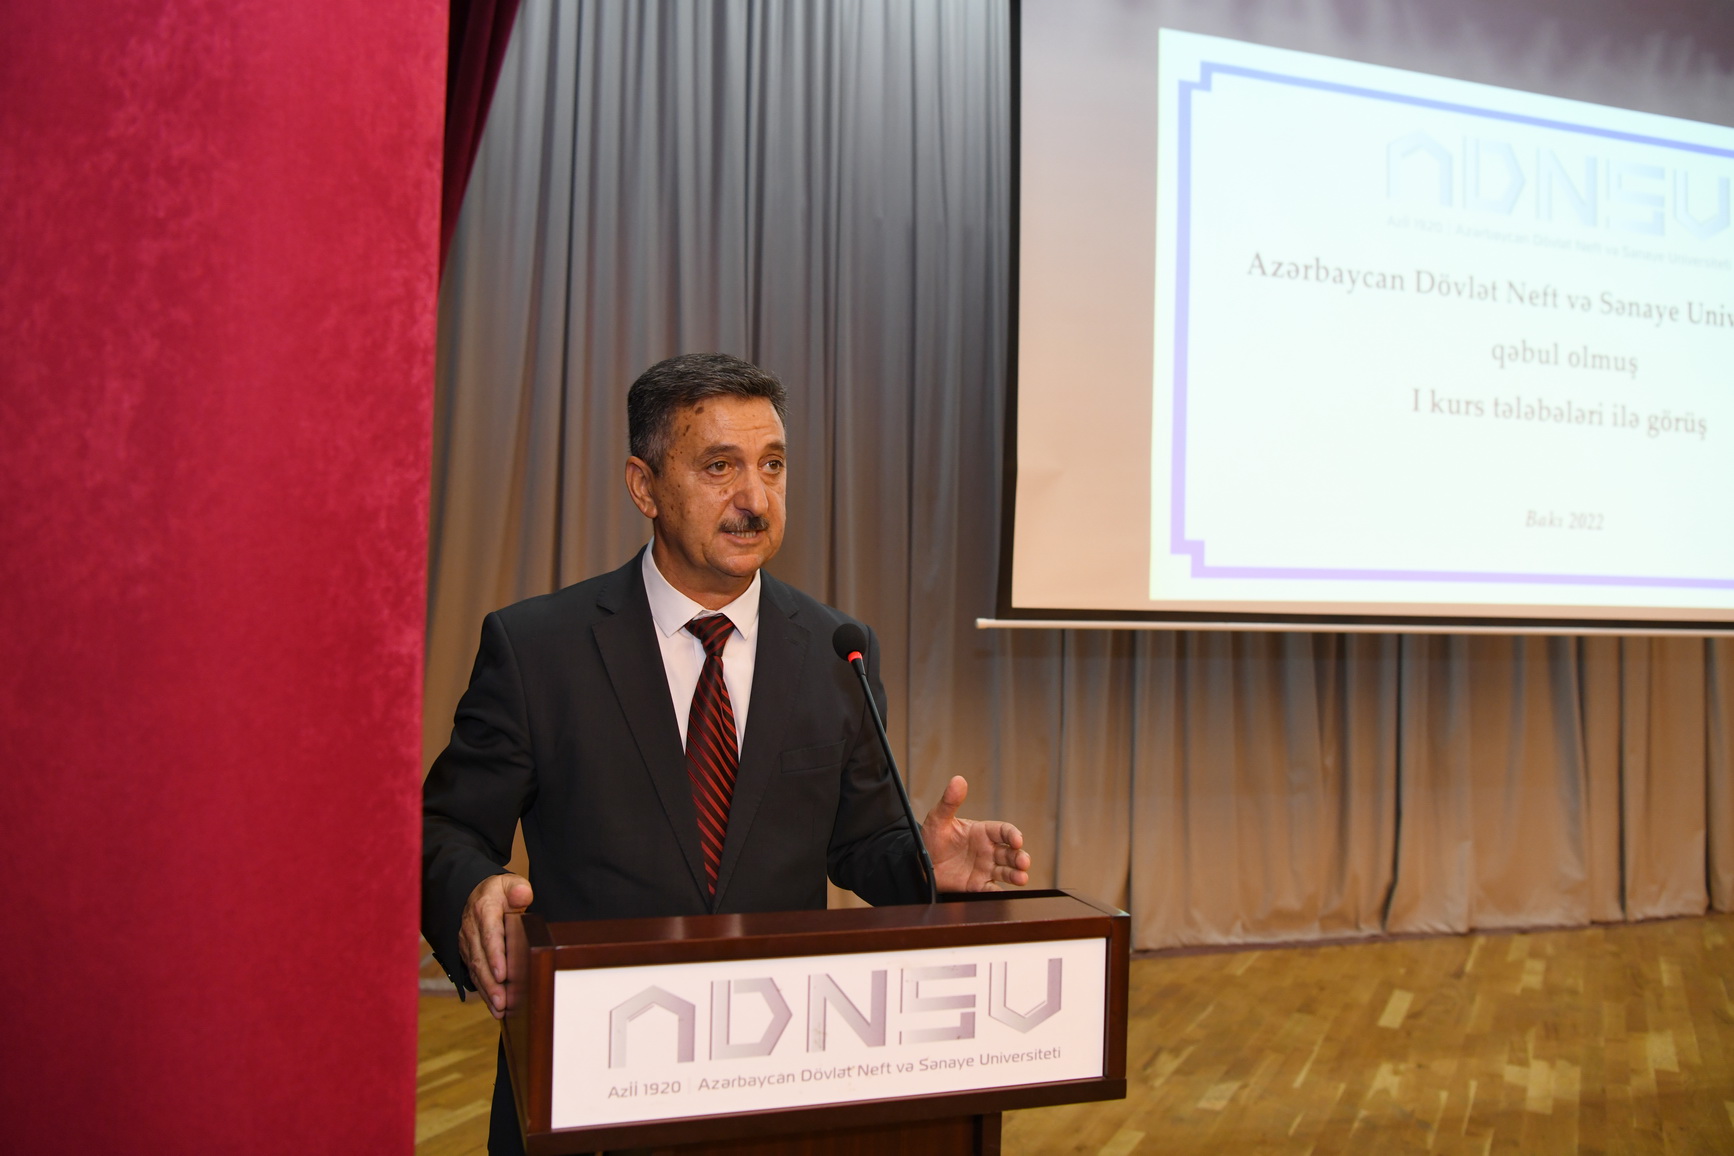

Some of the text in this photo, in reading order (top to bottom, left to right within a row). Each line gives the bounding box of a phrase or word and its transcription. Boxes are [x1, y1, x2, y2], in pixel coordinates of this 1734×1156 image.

[1247, 252, 1405, 294] Azərbaycan
[1415, 269, 1499, 302] Dövlət
[1506, 280, 1559, 309] Neft
[1567, 293, 1592, 312] və
[1600, 291, 1679, 328] Sənaye
[1491, 339, 1638, 380] qəbul olmuş
[1411, 388, 1708, 440] I kurs tələbələri ilə görüş
[1568, 511, 1605, 531] 2022
[608, 957, 1063, 1069] ADNSU
[643, 1080, 682, 1096] 1920
[698, 1072, 796, 1092] Azərbaycan
[800, 1066, 853, 1083] Dövlət
[857, 1063, 892, 1078] Neft
[896, 1062, 914, 1074] və
[918, 1056, 975, 1073] Sənaye
[979, 1046, 1062, 1066] Universiteti
